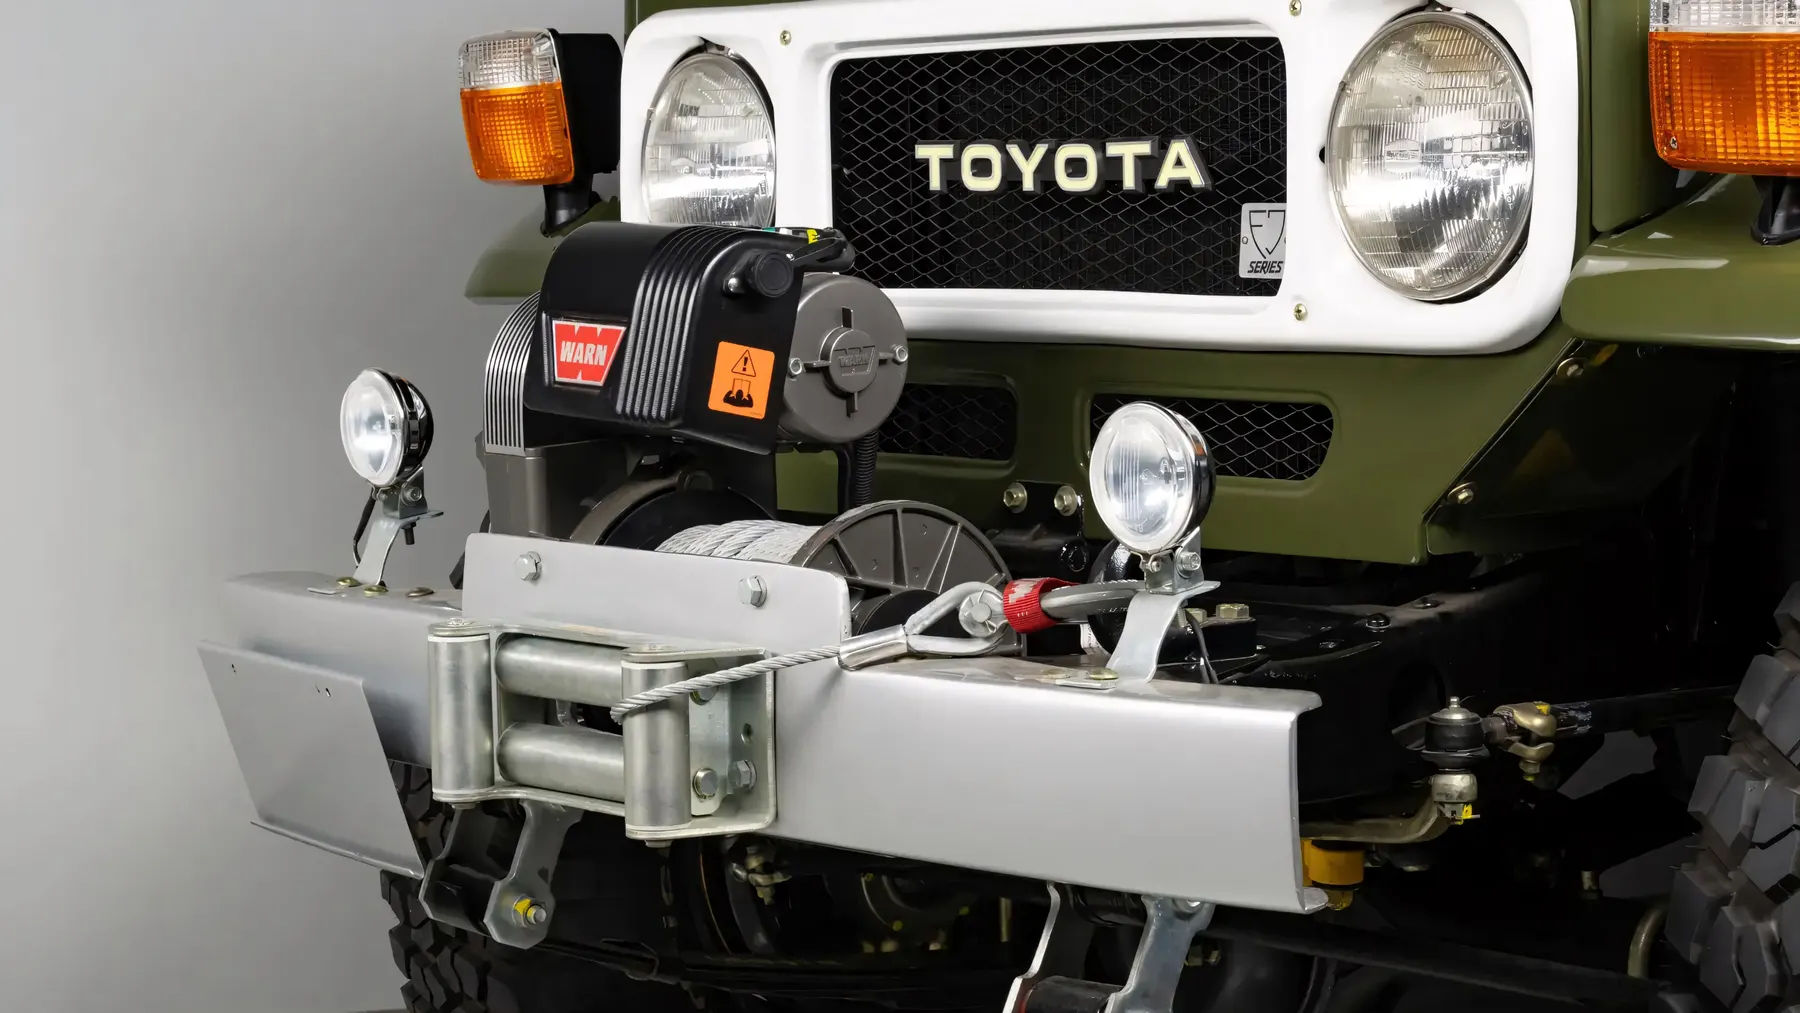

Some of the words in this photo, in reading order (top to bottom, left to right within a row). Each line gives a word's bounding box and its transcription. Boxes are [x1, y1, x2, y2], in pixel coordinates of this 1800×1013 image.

[915, 139, 1205, 191] TOYOTA
[1247, 261, 1284, 274] SERIES
[560, 341, 608, 366] WARN
